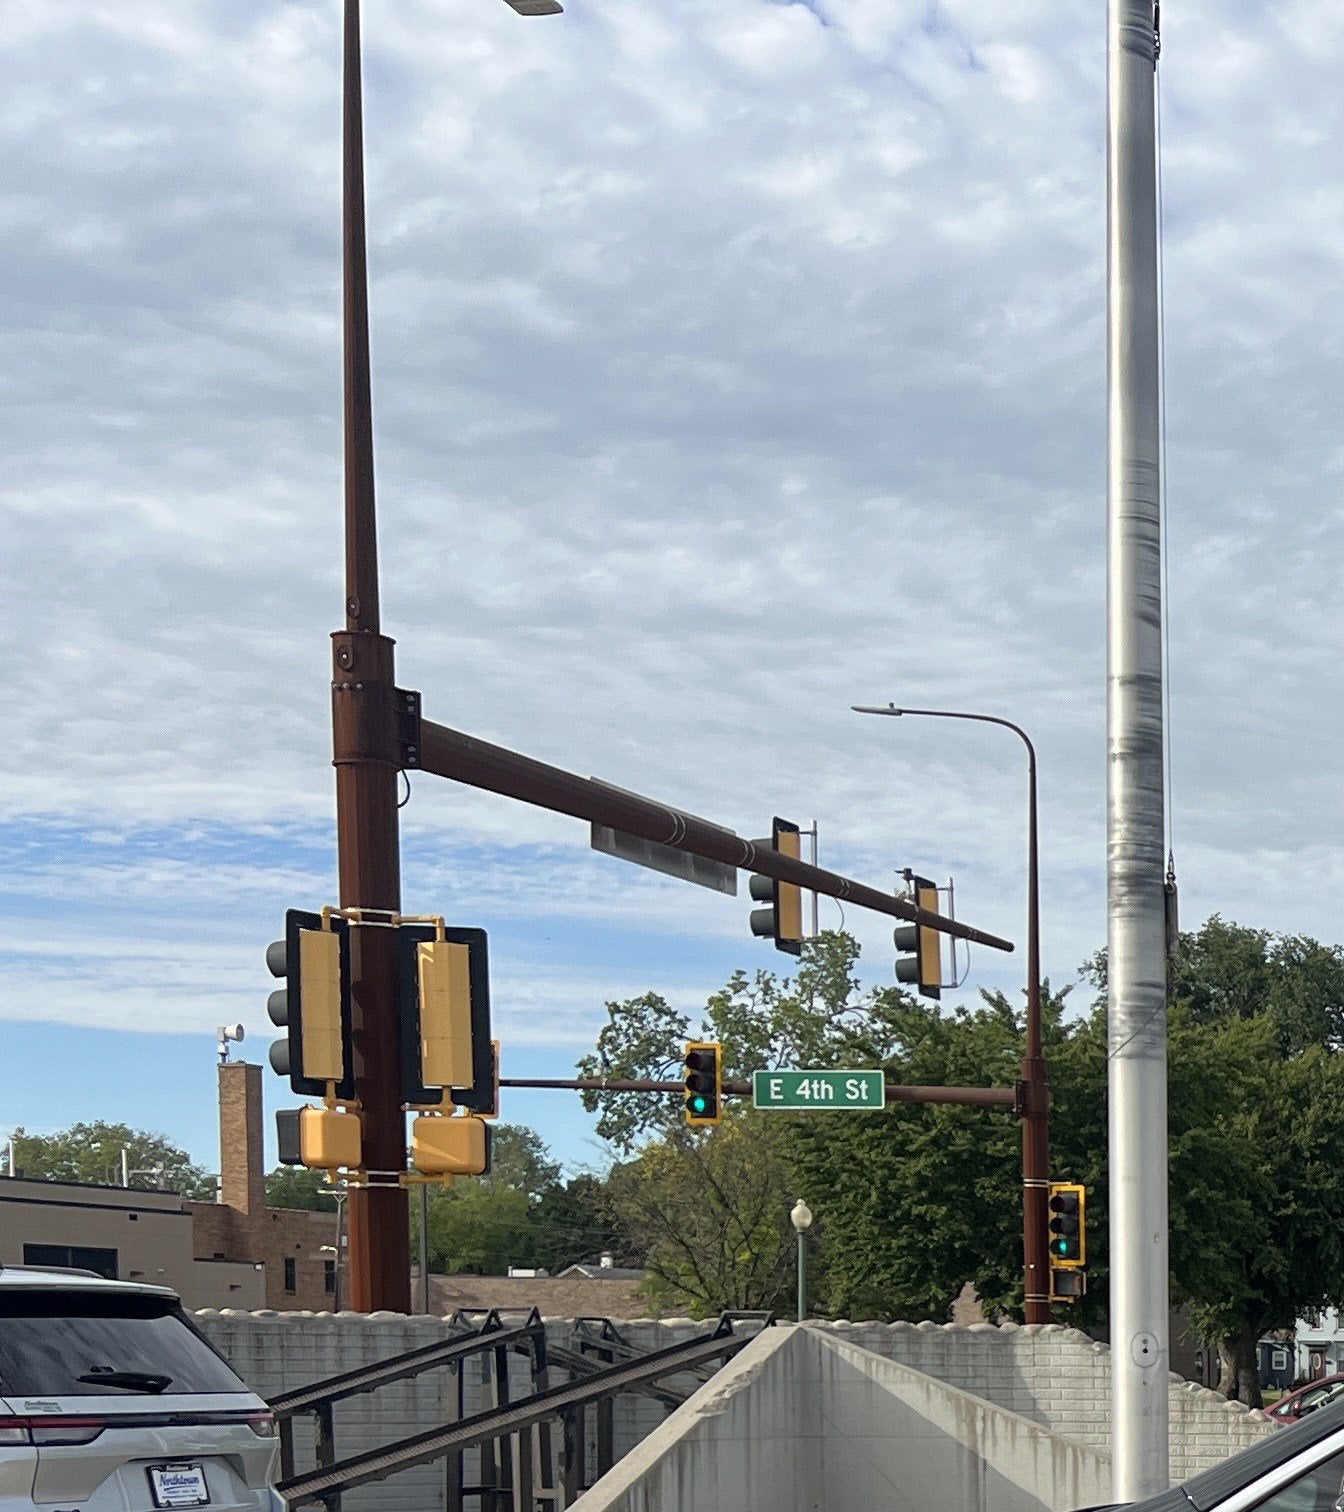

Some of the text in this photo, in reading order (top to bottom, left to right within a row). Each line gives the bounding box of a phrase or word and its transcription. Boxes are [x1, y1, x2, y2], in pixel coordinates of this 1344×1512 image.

[770, 1079, 868, 1099] E 4th St
